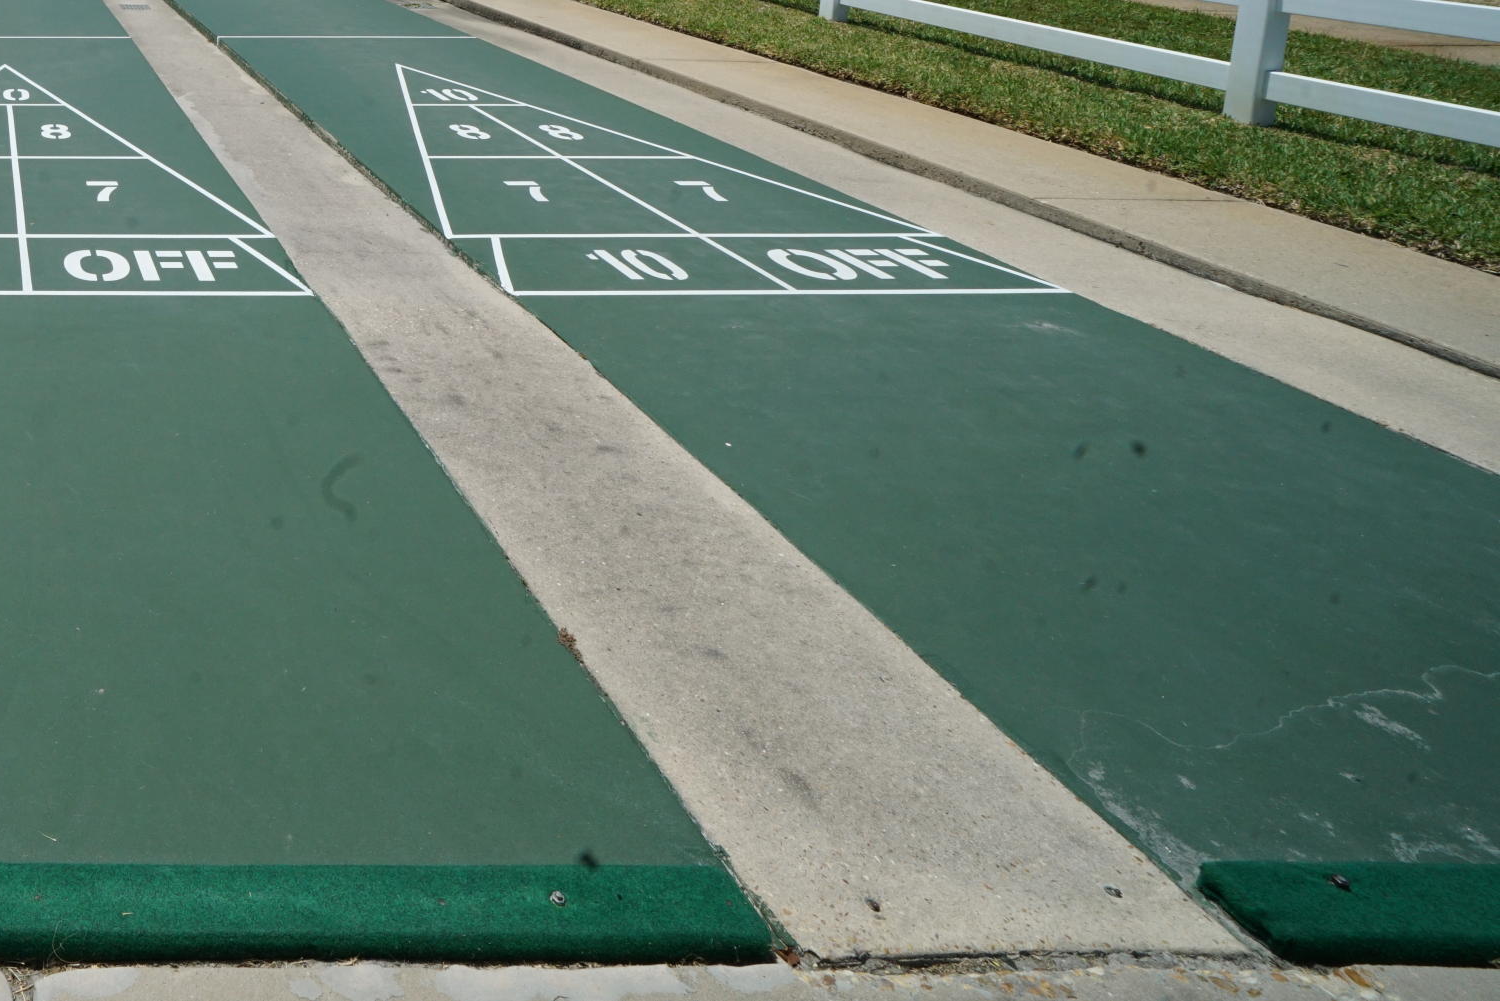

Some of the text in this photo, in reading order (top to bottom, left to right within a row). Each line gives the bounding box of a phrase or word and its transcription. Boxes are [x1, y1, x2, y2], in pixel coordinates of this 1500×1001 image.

[420, 88, 479, 101] 10
[41, 123, 72, 139] 8
[448, 124, 491, 140] 8
[539, 124, 584, 140] 8
[86, 180, 119, 202] 7
[504, 180, 550, 201] 7
[674, 180, 729, 201] 7
[63, 249, 239, 282] OFF
[585, 249, 689, 281] 10
[767, 248, 949, 280] OFF
